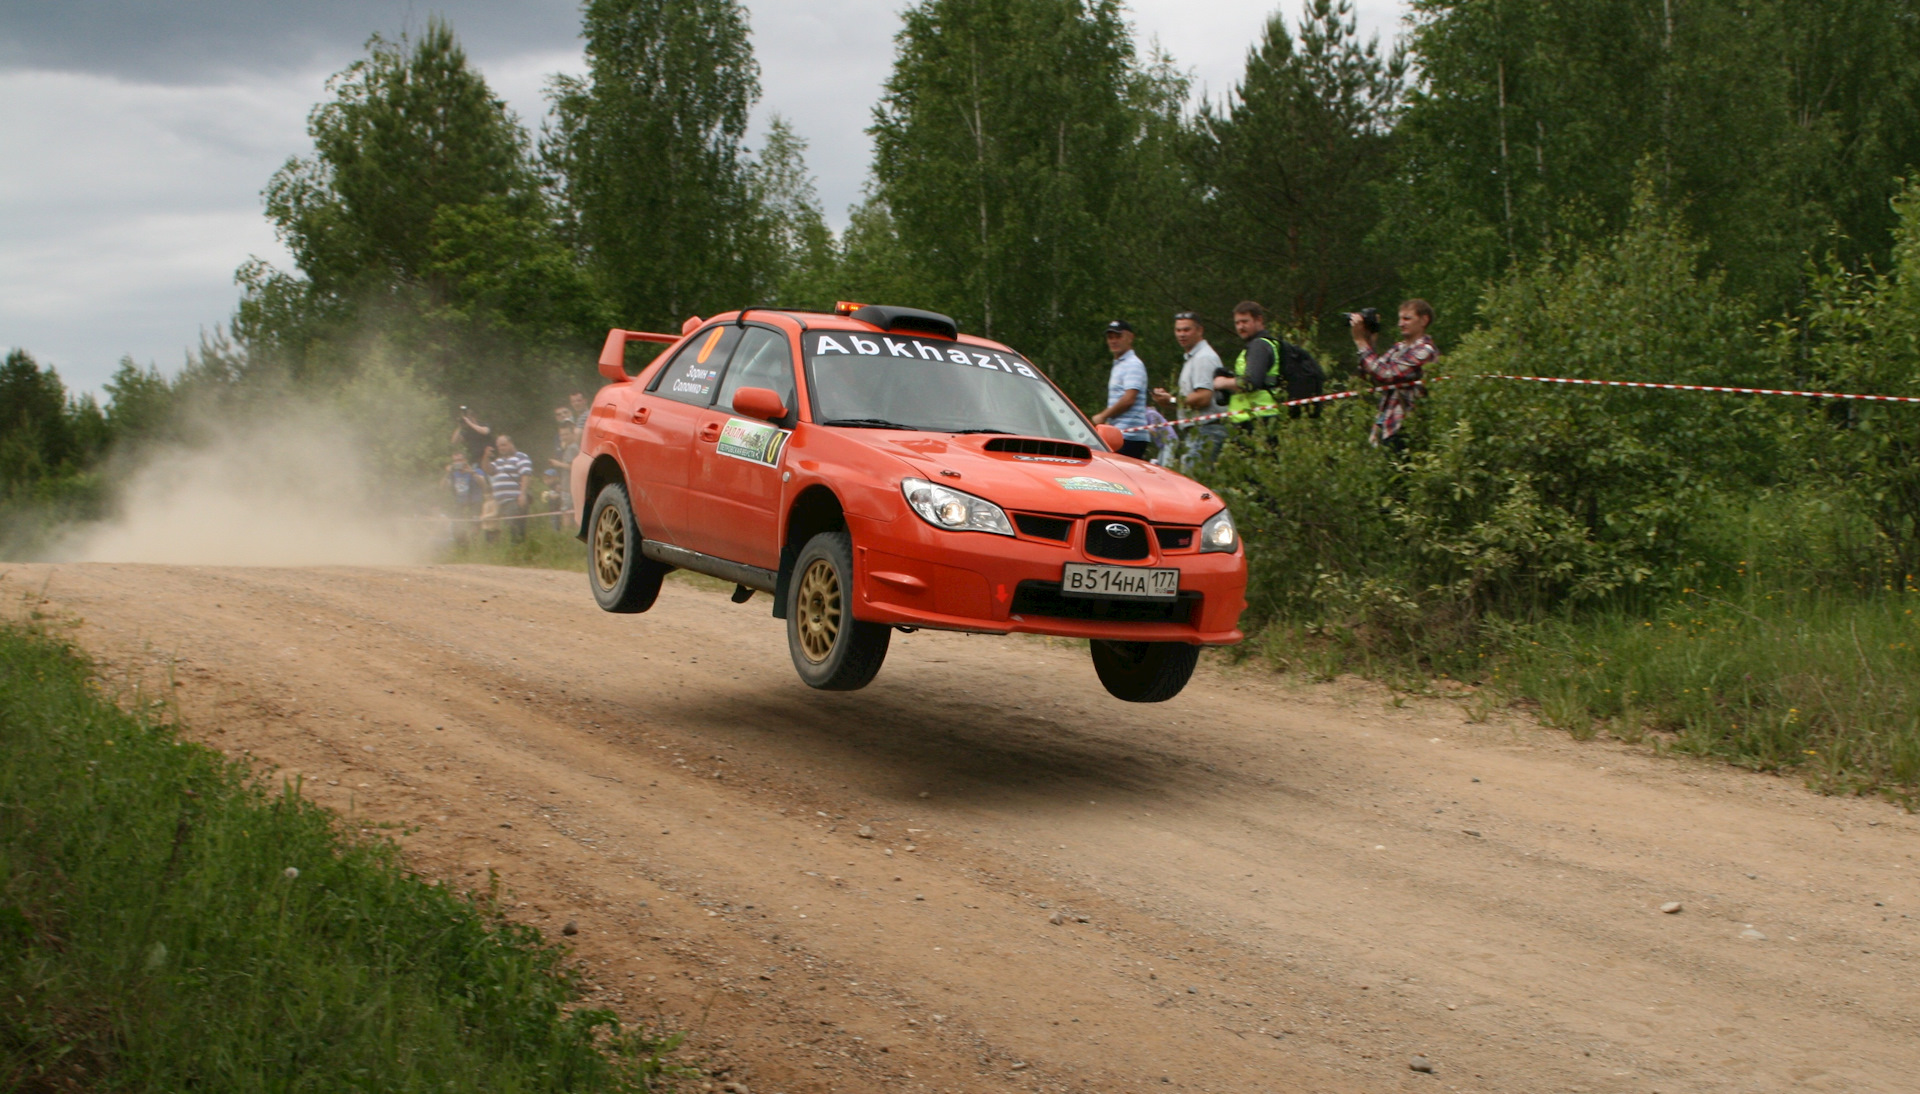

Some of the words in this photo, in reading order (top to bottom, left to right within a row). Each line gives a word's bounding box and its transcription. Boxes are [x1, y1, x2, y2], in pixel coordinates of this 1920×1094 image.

[816, 335, 1039, 380] Abkhazia
[686, 364, 708, 380] Зорин
[673, 378, 702, 394] Соломко
[724, 425, 746, 440] РАЛЛИ
[767, 431, 783, 463] 0
[1071, 569, 1146, 593] В514НА
[1151, 572, 1175, 587] 177
